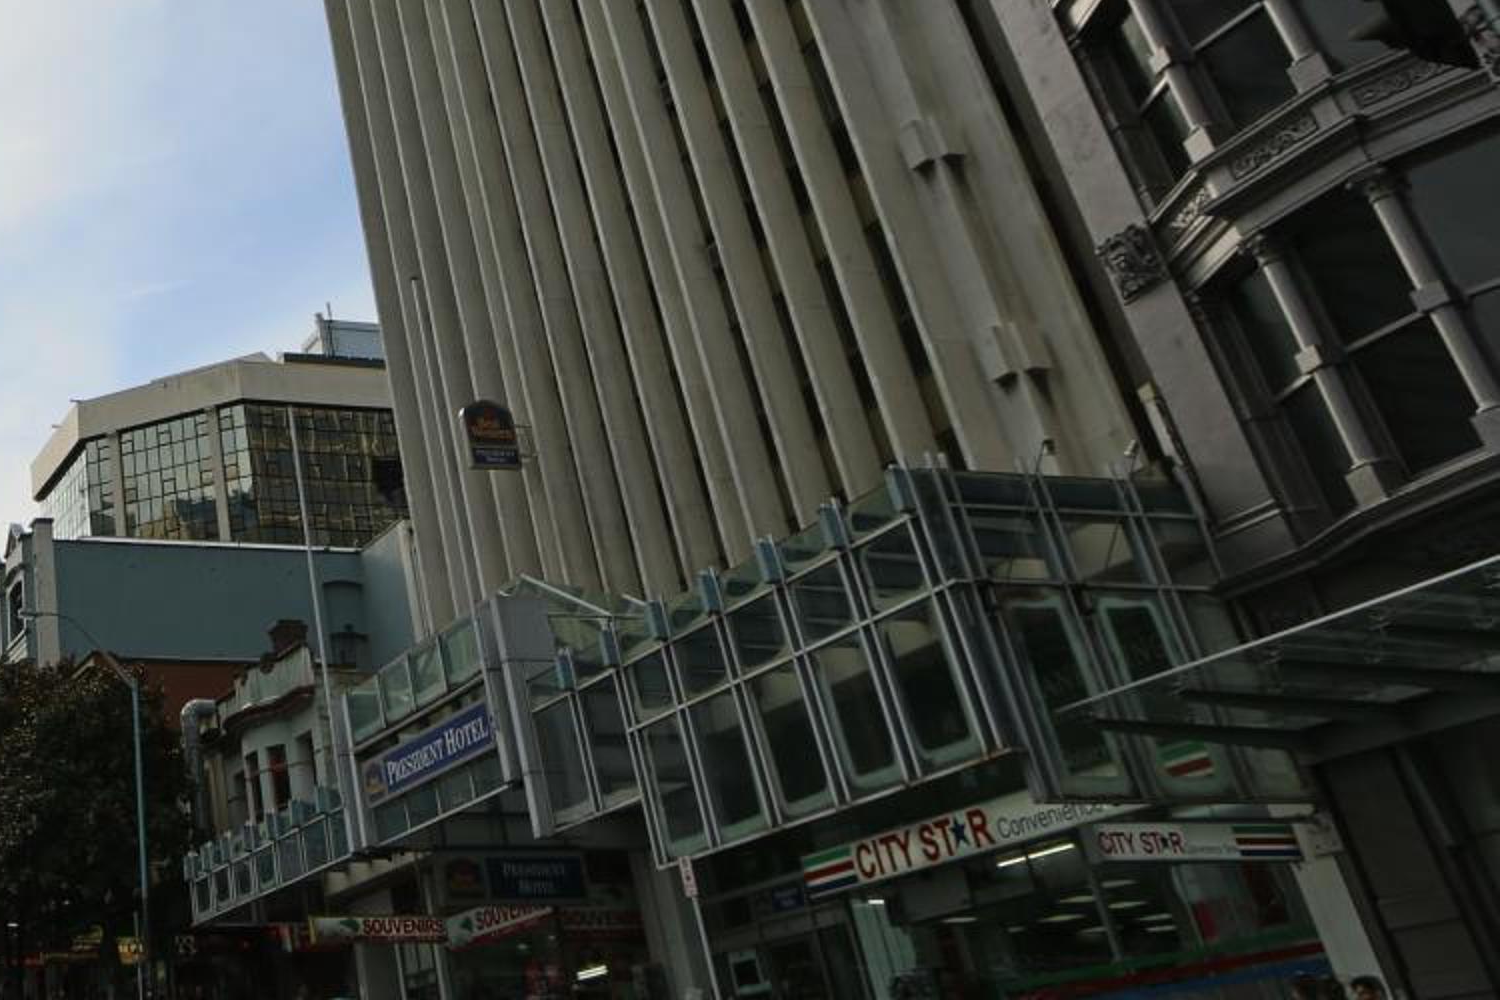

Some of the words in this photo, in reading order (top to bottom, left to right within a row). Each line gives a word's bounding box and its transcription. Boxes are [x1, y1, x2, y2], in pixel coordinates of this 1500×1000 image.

[387, 737, 444, 786] PRESIDENT
[444, 716, 488, 756] HOTEL
[856, 830, 912, 879] CITY
[1099, 832, 1133, 854] CITY
[363, 918, 444, 935] SOUVENIRS
